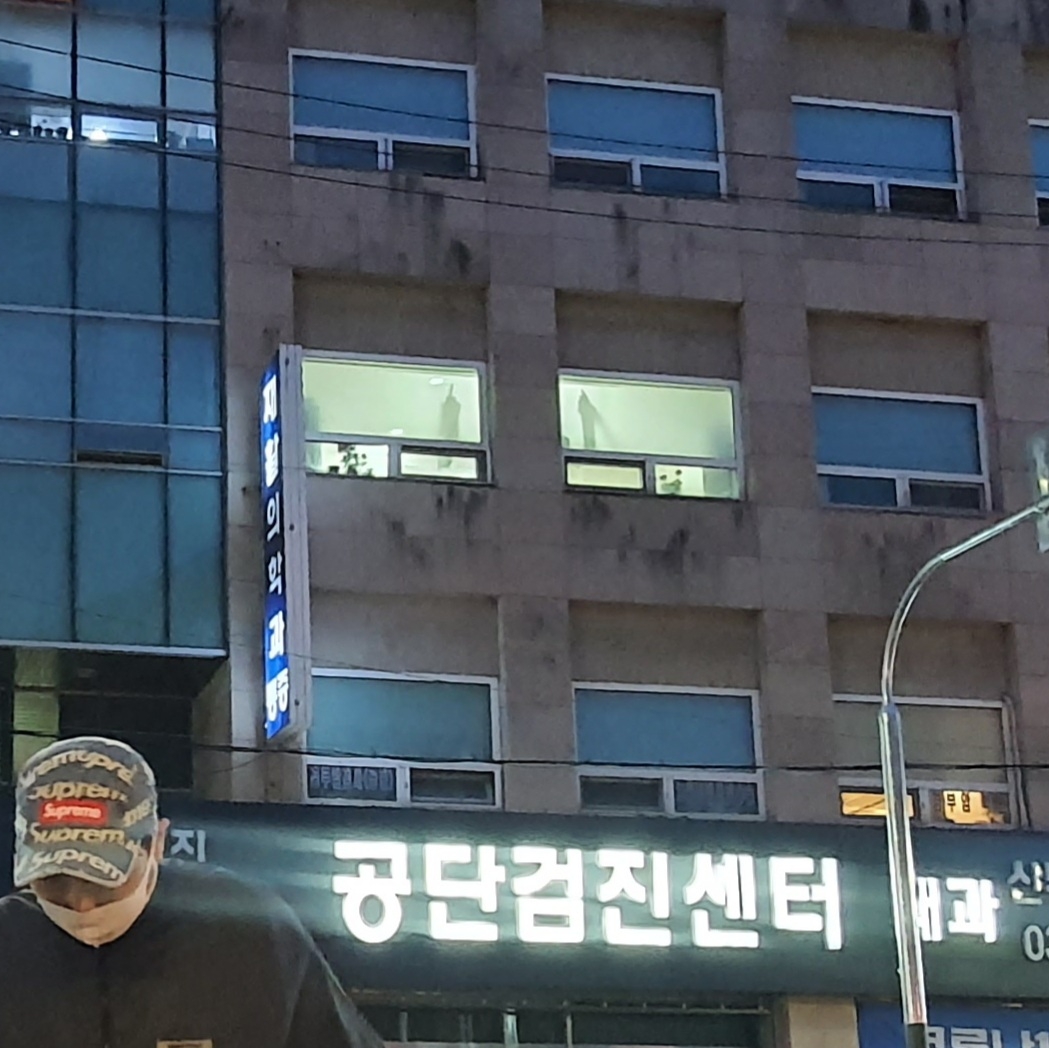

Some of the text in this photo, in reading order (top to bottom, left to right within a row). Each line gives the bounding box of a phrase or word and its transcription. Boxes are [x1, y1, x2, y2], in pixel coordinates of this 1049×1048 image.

[43, 803, 102, 819] Supreme
[333, 838, 842, 951] 공단검진센터
[1023, 924, 1049, 962] 0
